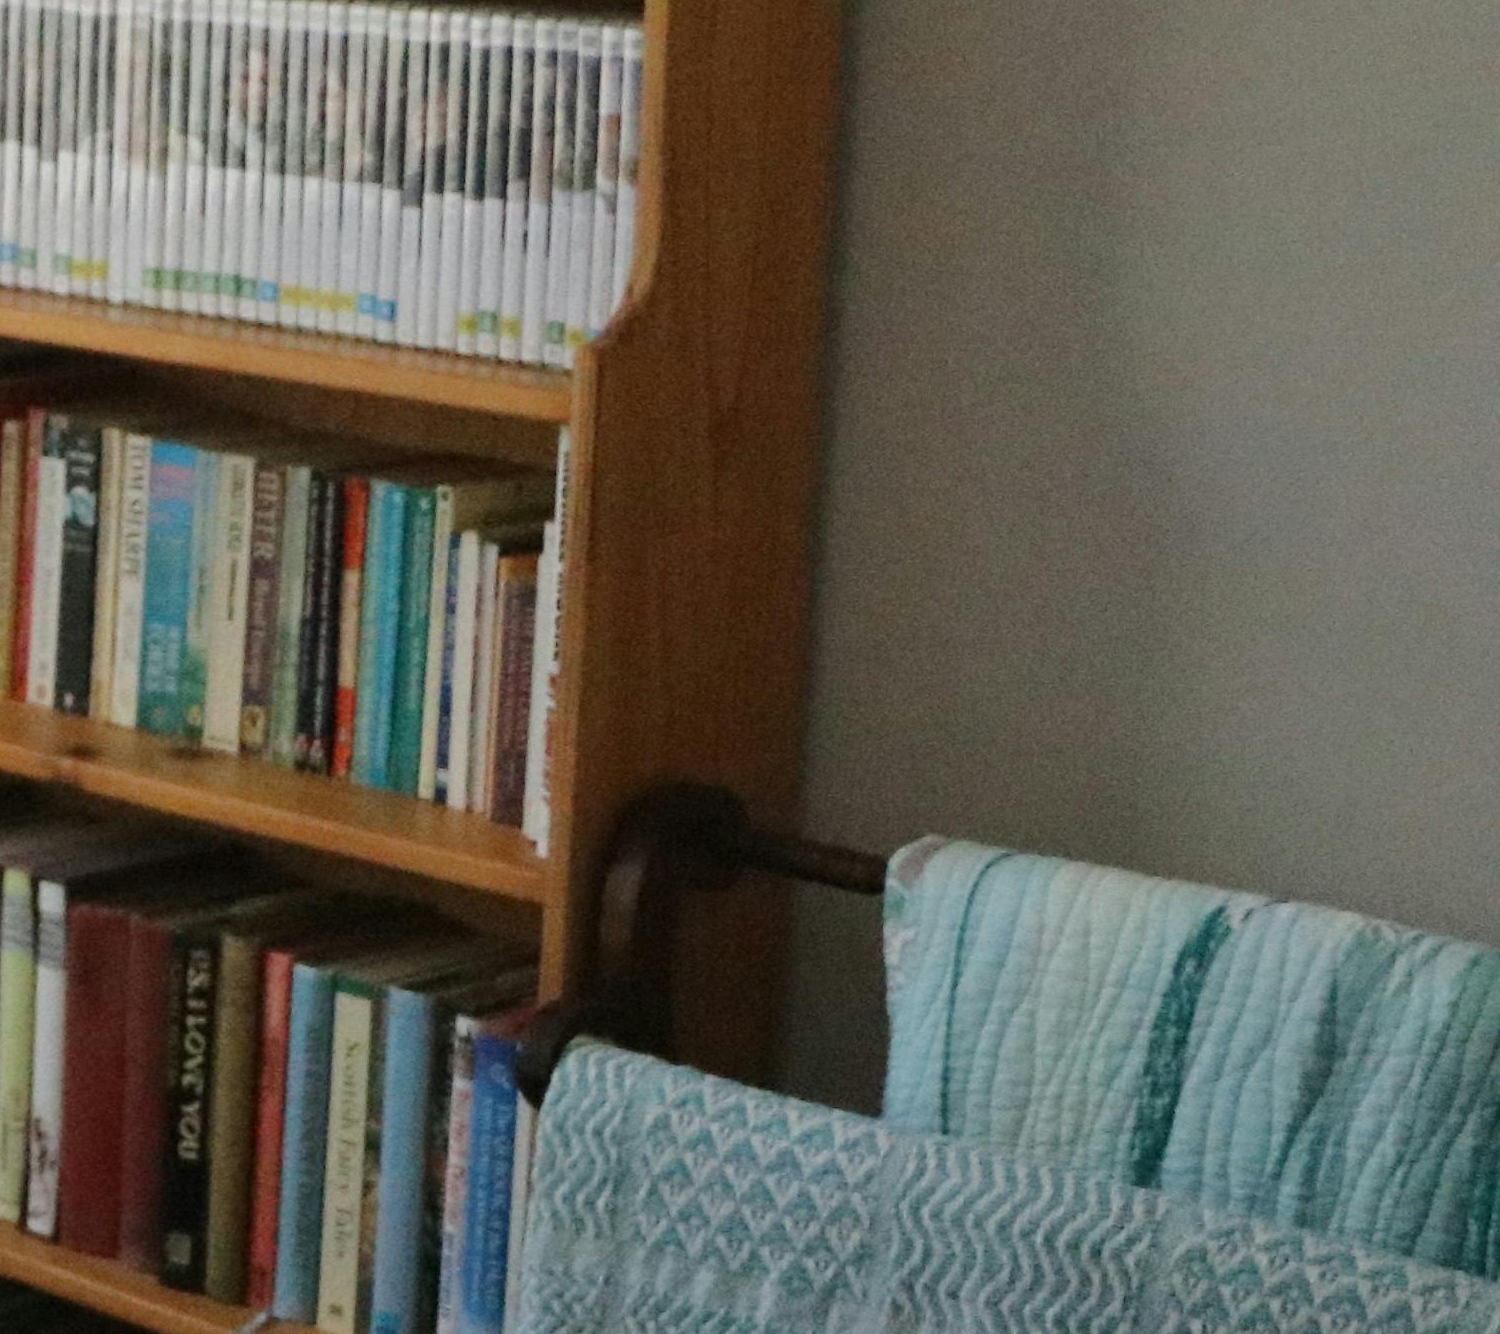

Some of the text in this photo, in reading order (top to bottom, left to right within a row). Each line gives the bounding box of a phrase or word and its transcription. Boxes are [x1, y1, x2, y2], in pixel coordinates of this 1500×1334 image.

[123, 443, 146, 581] TOM SHARPE
[180, 1013, 207, 1096] LOVE
[177, 1102, 202, 1161] YOU
[334, 1040, 360, 1260] Scottish Fairy Tales
